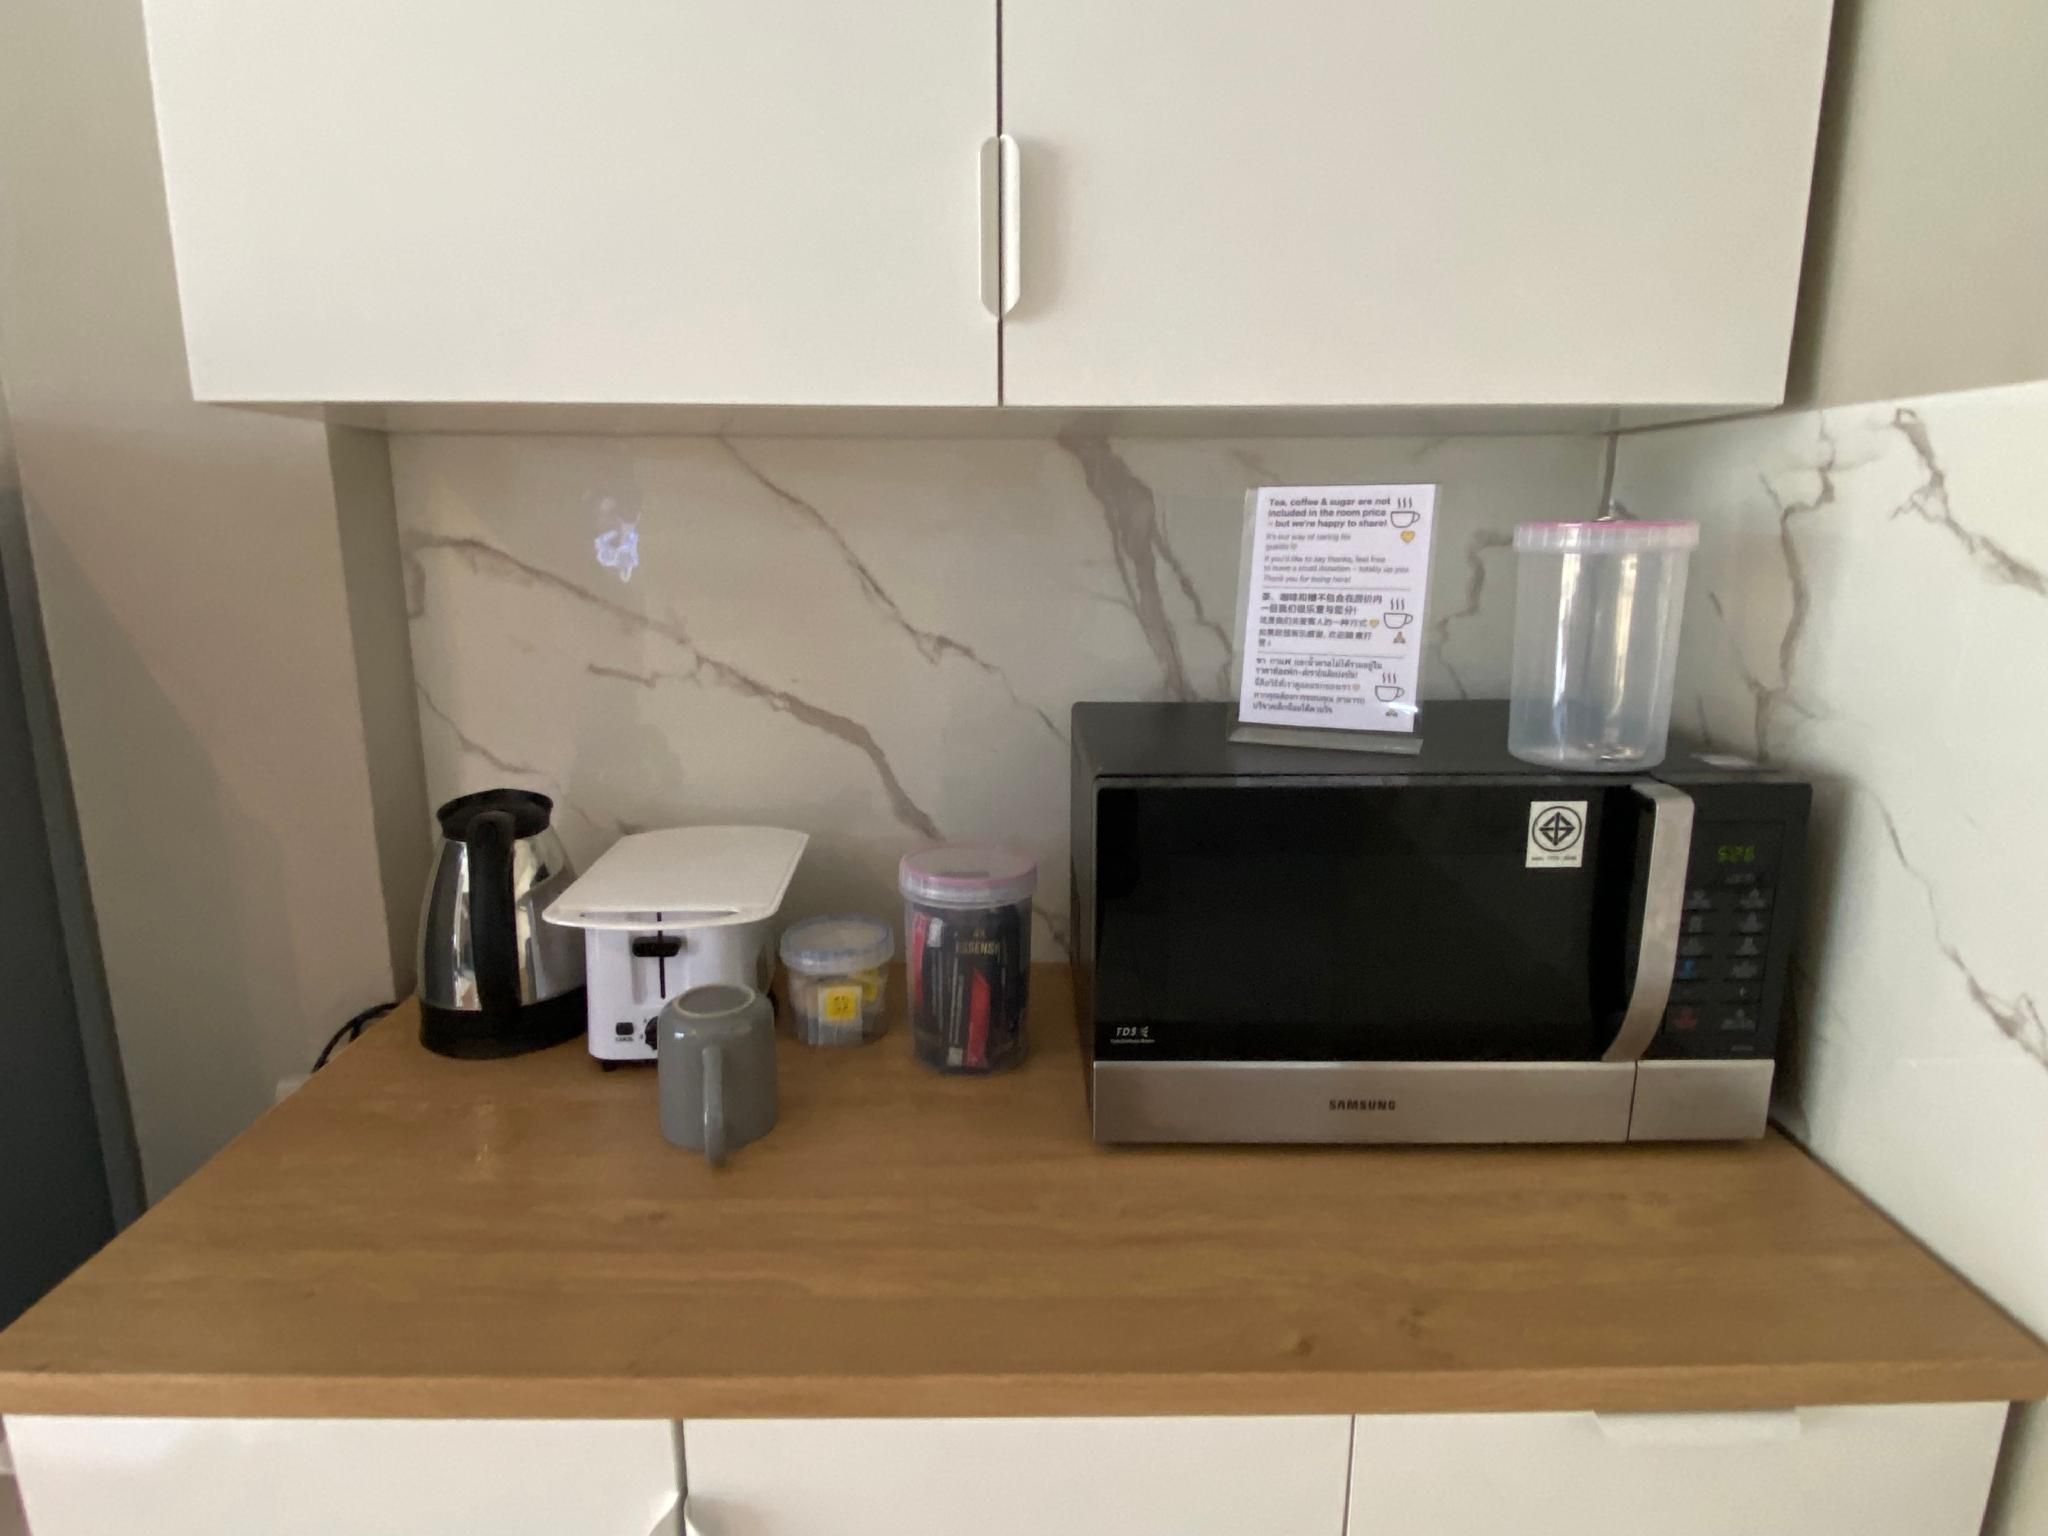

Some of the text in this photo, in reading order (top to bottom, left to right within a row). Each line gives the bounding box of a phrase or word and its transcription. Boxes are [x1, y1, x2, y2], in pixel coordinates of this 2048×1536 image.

[1270, 499, 1288, 507] Tea,
[1290, 498, 1318, 506] coffee
[1330, 499, 1355, 507] sugar
[1375, 497, 1390, 505] not
[1268, 509, 1306, 517] included
[1309, 509, 1317, 517] in
[1362, 509, 1386, 517] price
[1318, 520, 1345, 528] happy
[1329, 1099, 1396, 1111] SAMSUNG
